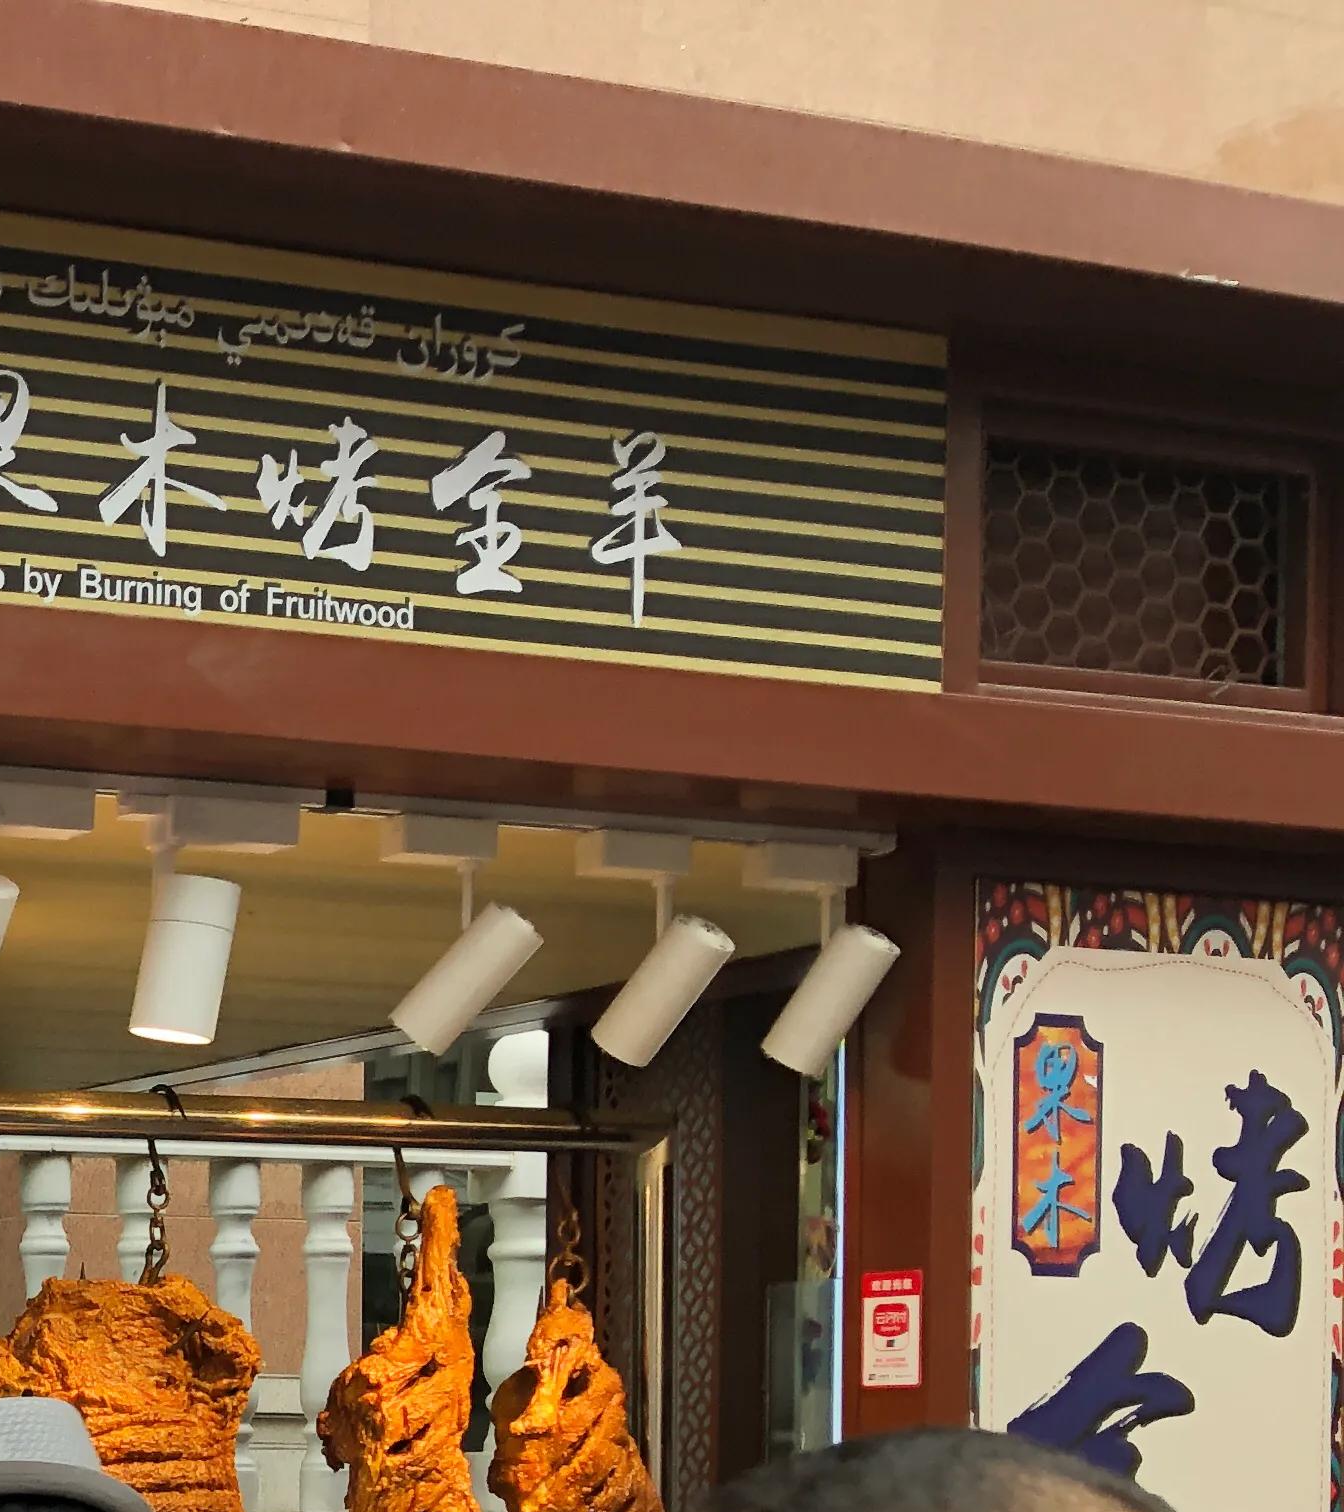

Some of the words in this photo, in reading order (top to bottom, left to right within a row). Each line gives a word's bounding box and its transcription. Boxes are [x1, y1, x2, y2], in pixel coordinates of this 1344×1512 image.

[22, 563, 61, 603] by
[79, 566, 203, 617] Burning
[219, 580, 250, 614] of
[267, 586, 414, 631] Fruitwood
[1024, 1043, 1092, 1250] 果木
